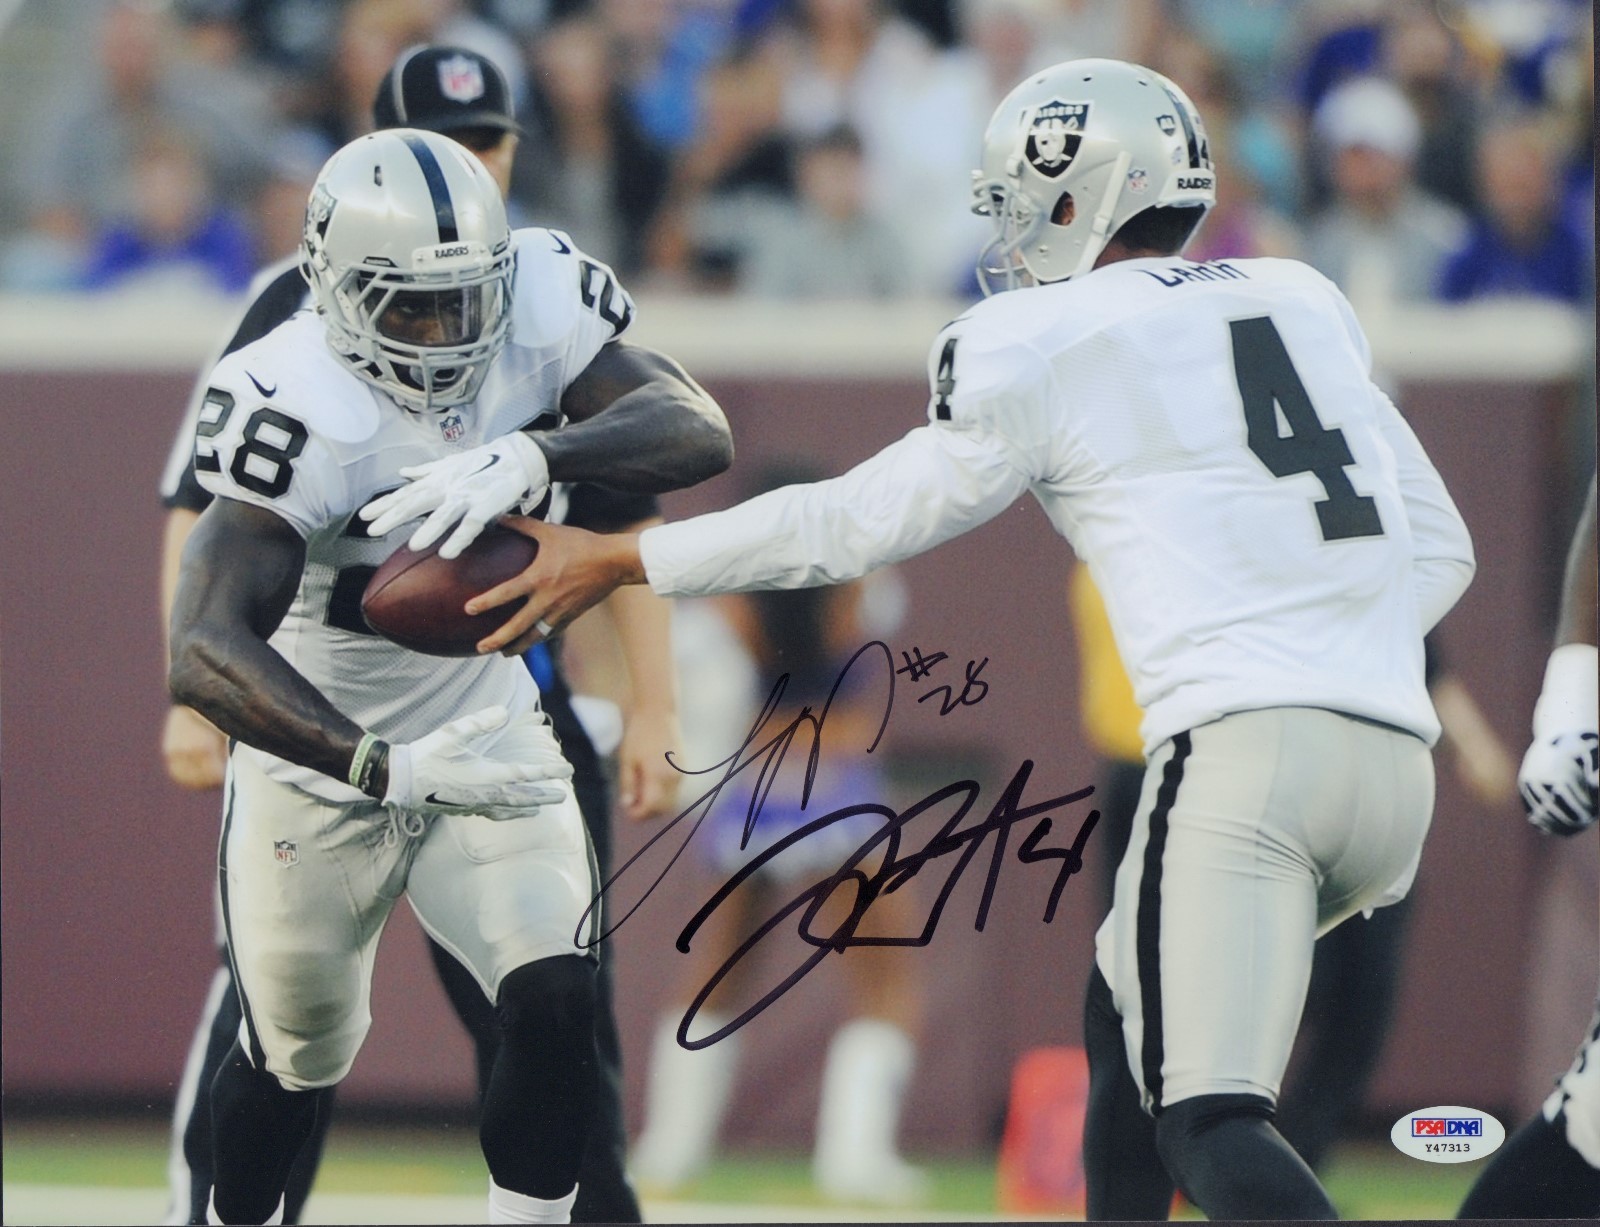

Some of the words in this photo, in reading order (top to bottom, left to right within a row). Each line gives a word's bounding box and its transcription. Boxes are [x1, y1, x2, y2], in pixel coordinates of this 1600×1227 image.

[434, 245, 469, 259] RAIDERS
[936, 338, 958, 421] 4
[1229, 316, 1384, 541] 4
[194, 386, 309, 499] 28
[276, 850, 297, 863] NFL
[1415, 1120, 1445, 1136] PSA
[1447, 1120, 1479, 1136] DNA
[1425, 1143, 1471, 1153] Y47313
